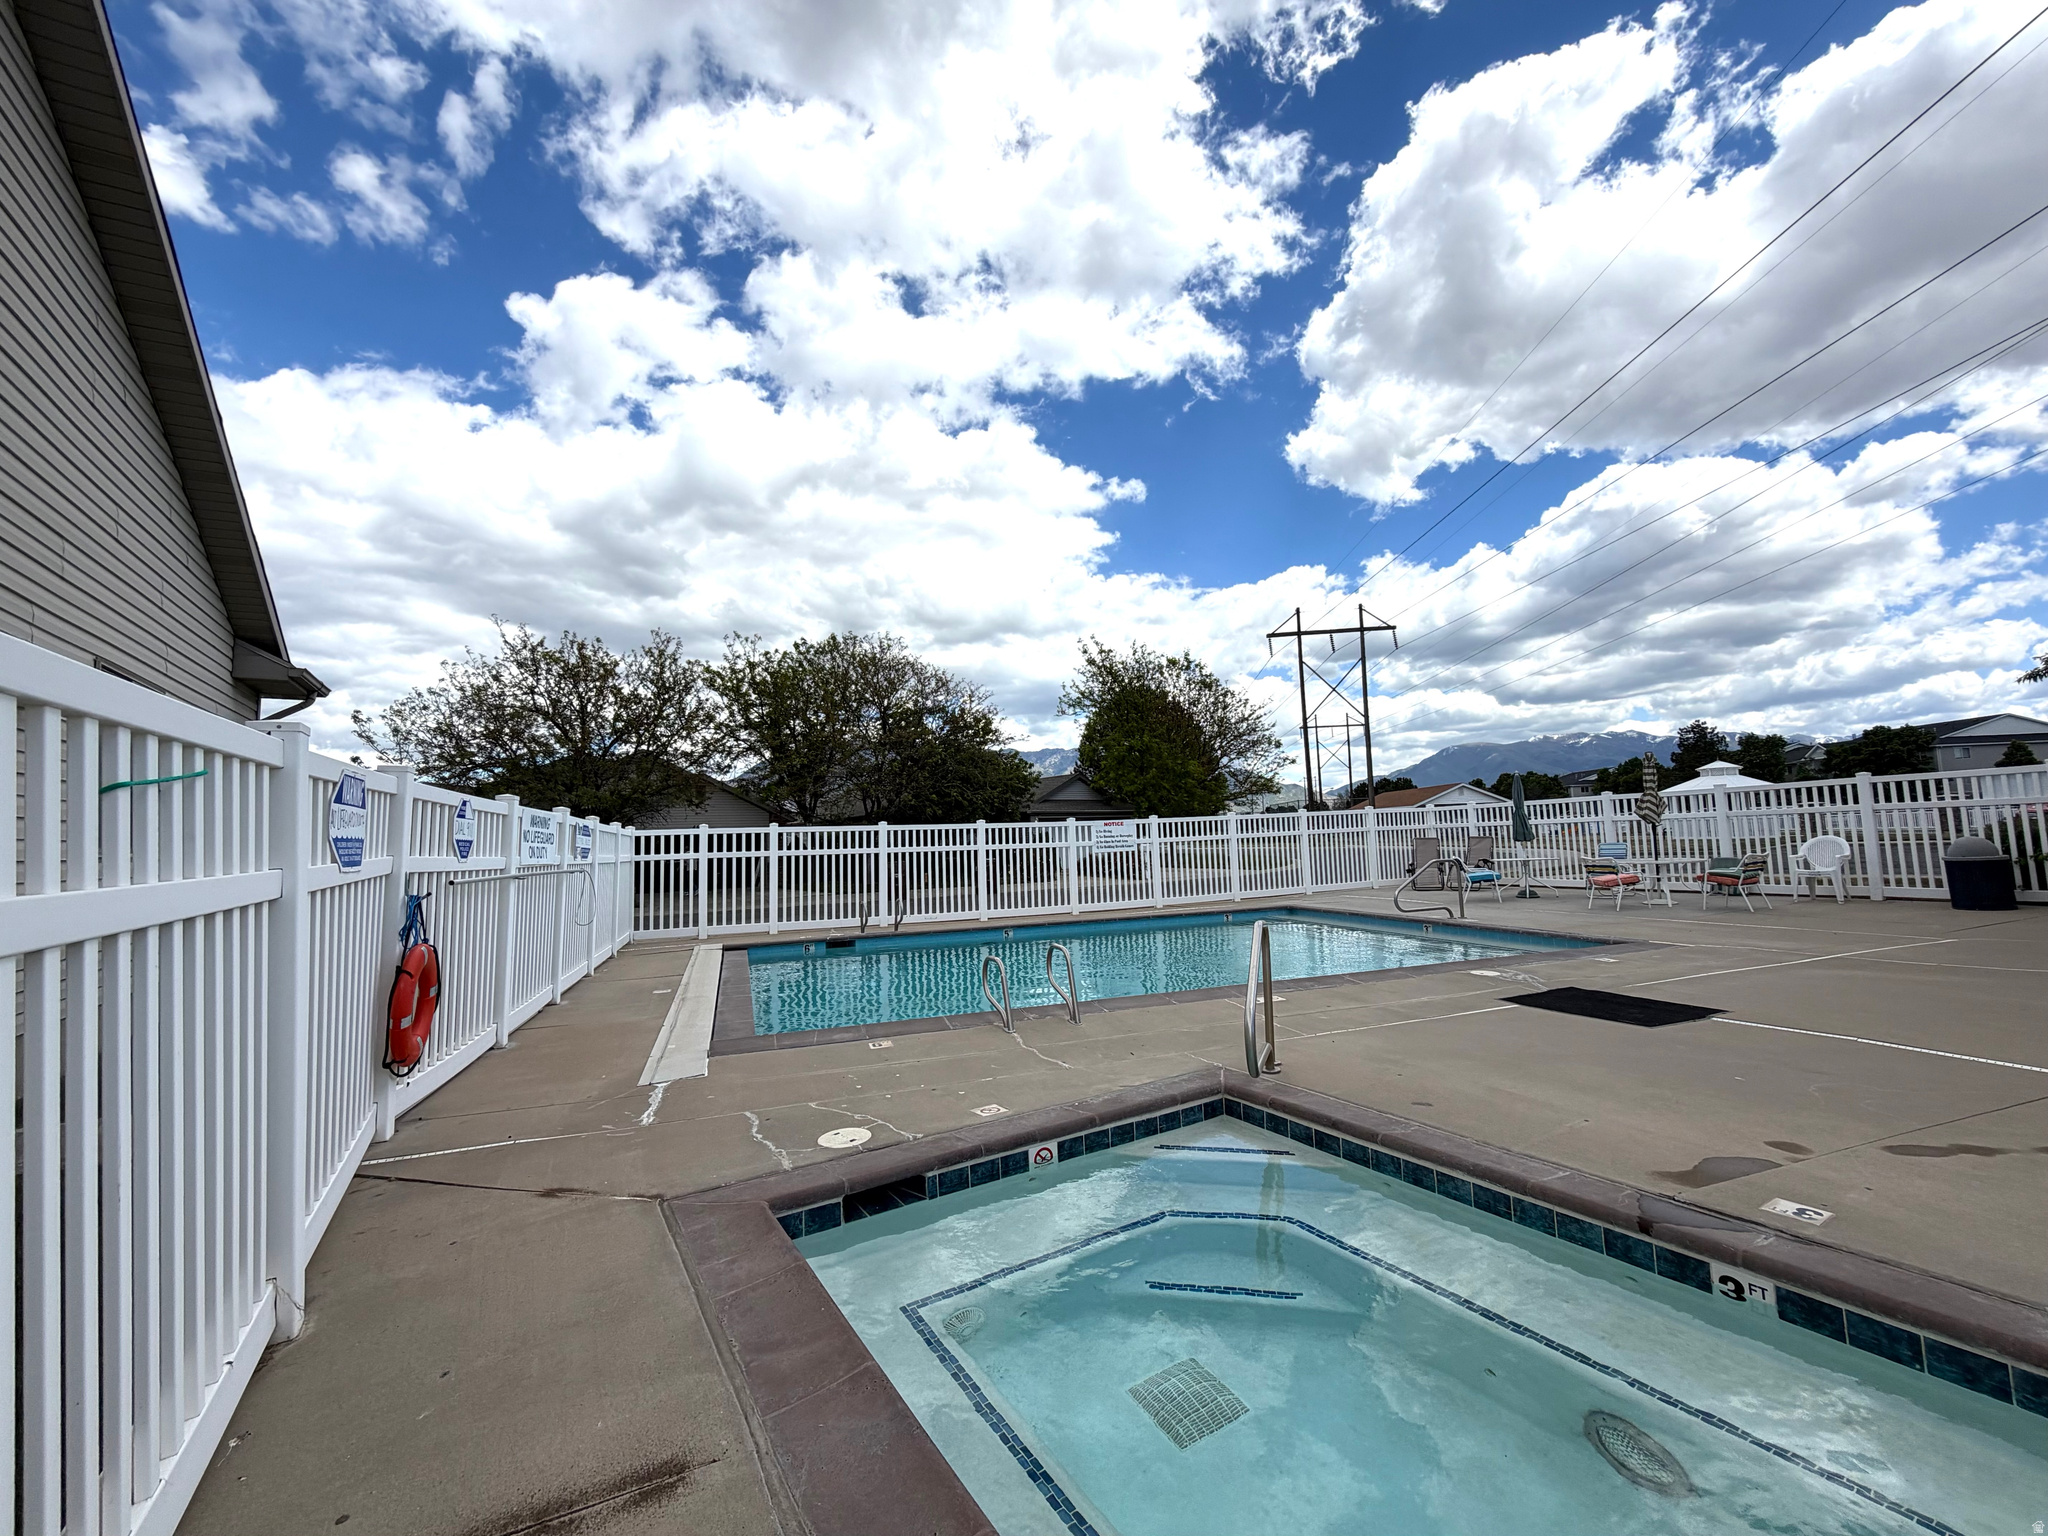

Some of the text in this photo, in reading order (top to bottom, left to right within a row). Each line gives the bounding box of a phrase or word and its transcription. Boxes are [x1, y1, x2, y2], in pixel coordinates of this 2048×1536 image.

[341, 775, 365, 807] WARNING
[454, 820, 466, 836] DIAL
[530, 814, 551, 830] WARNING
[523, 829, 555, 845] NO LIFEGUARD
[528, 845, 548, 859] ON DUTY
[1791, 1207, 1824, 1221] 3
[1718, 1274, 1769, 1302] 3 FT
